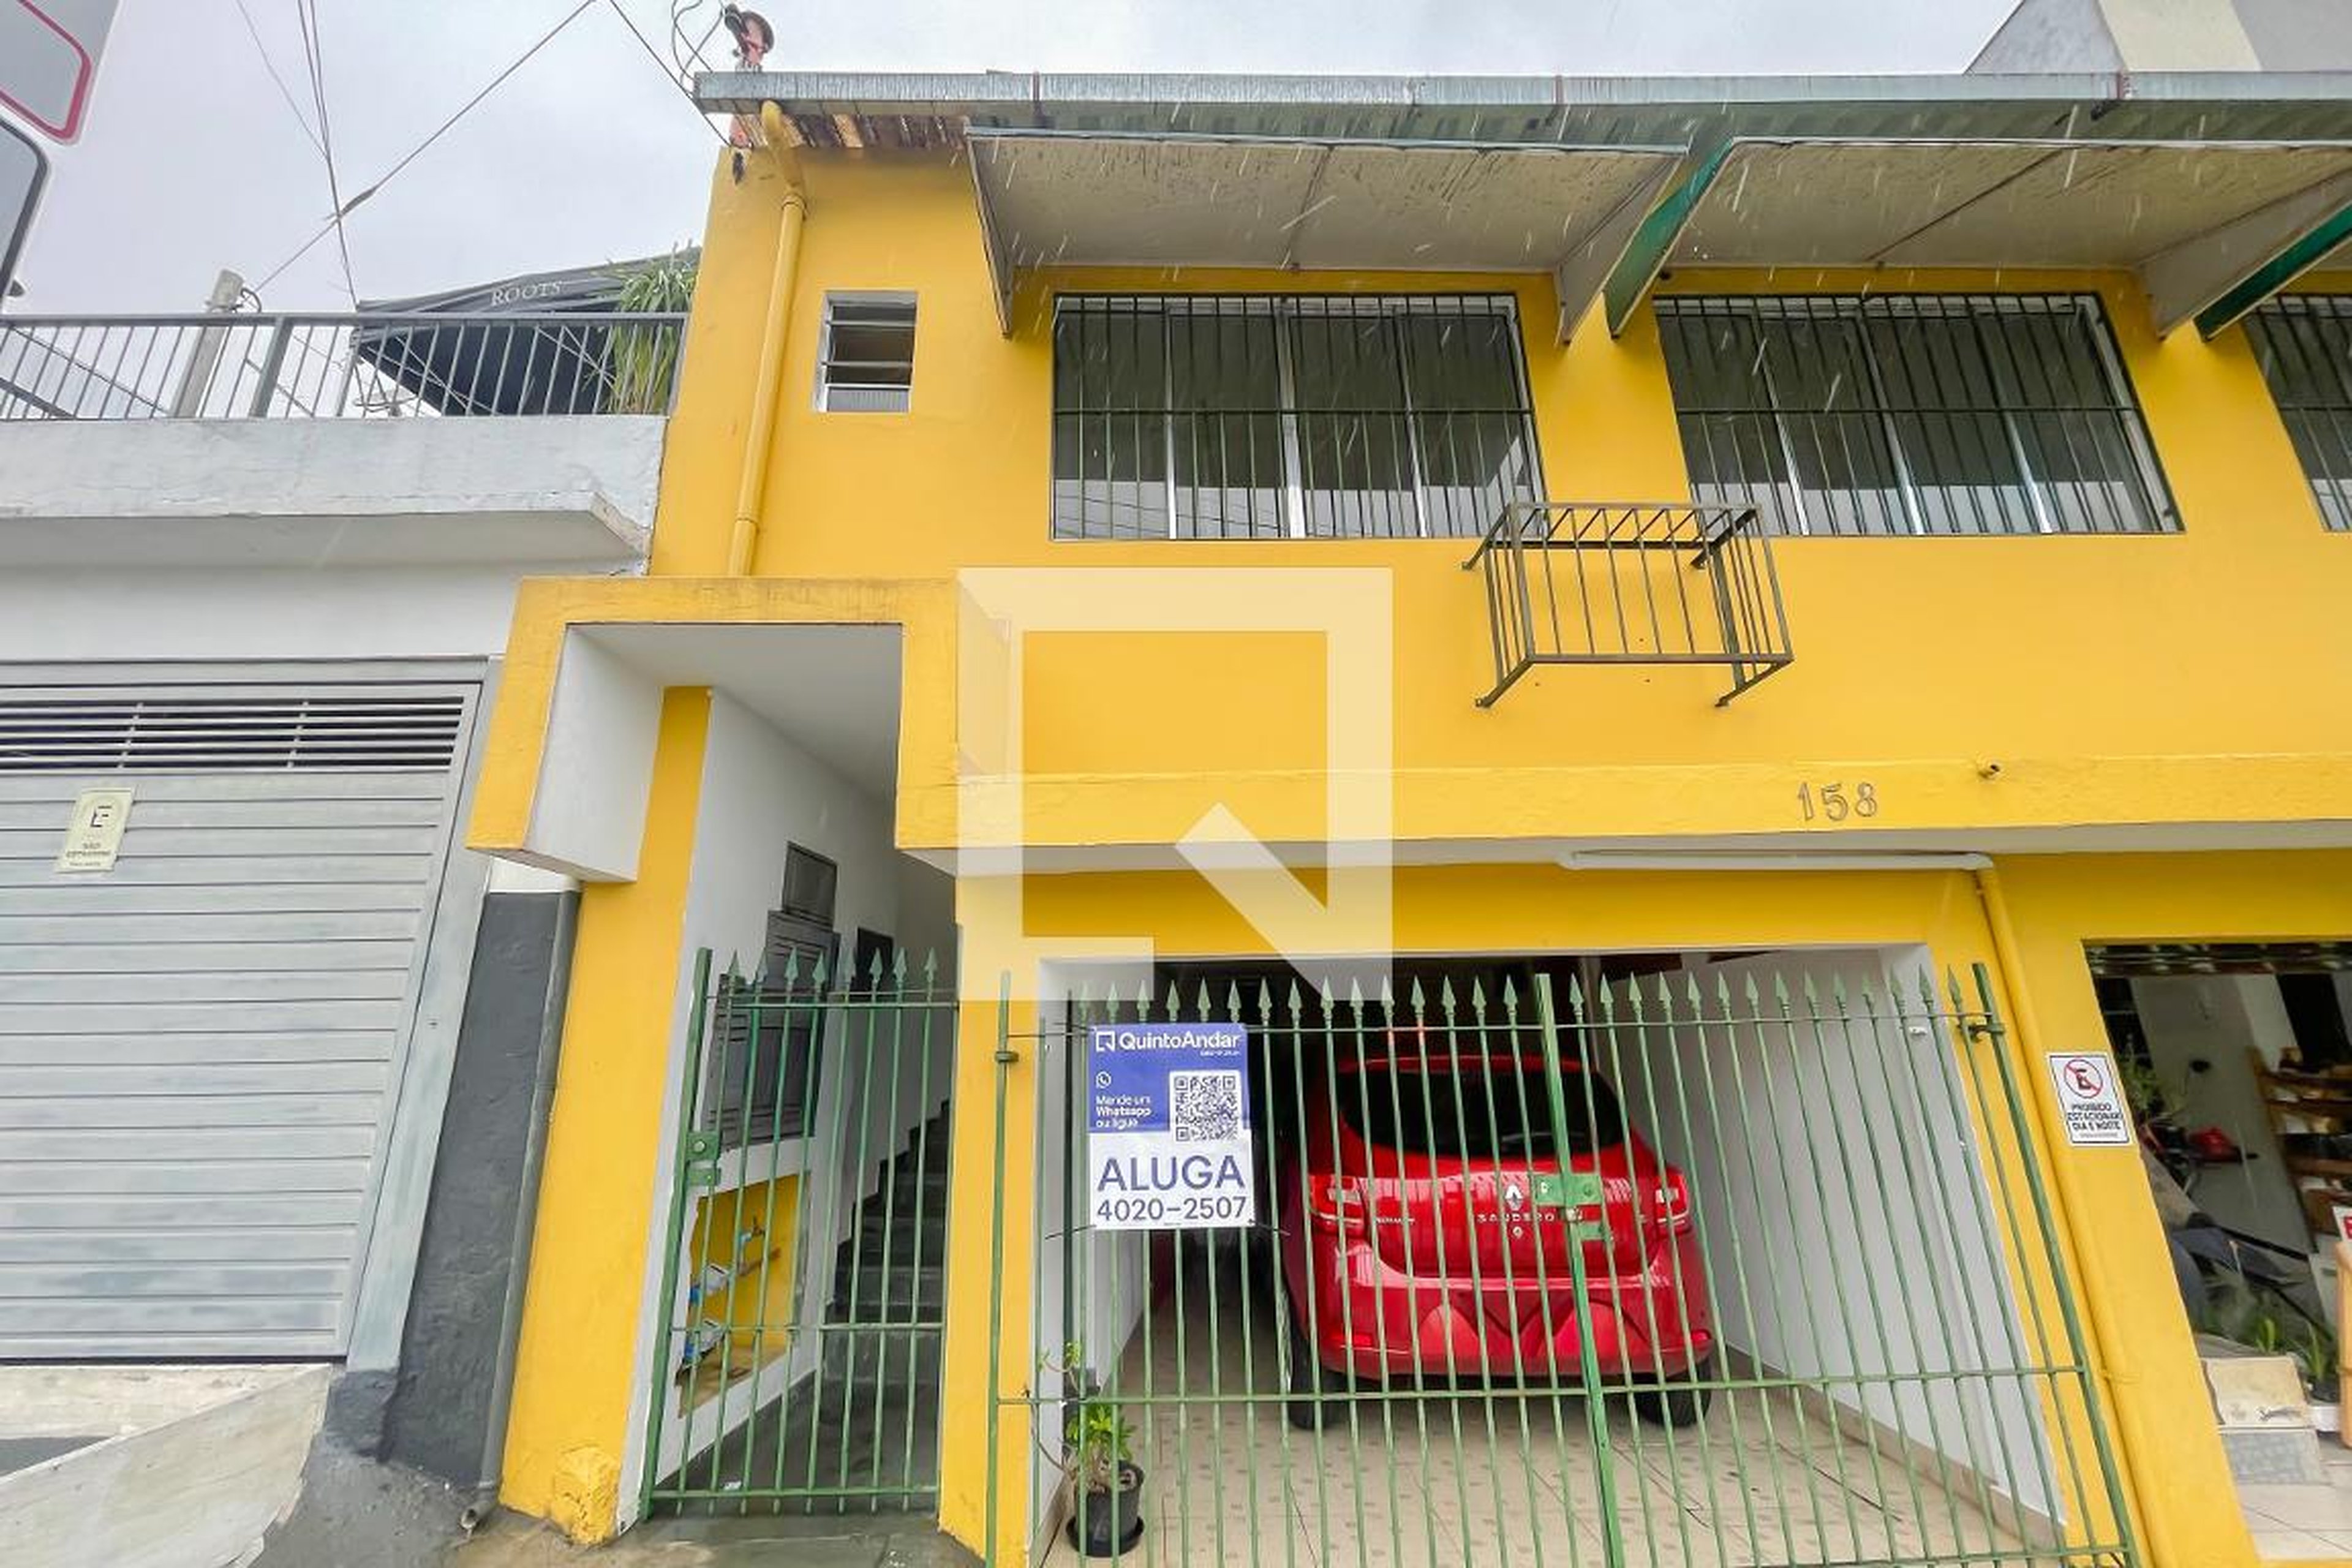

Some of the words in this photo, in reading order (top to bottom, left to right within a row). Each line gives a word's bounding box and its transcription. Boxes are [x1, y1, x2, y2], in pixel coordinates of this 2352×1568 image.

[491, 281, 562, 306] ROOTS
[1798, 782, 1877, 821] 158
[1119, 1030, 1241, 1050] QuintoAndar
[1097, 1155, 1246, 1191] ALUGA
[1097, 1196, 1247, 1222] 4020-2507
